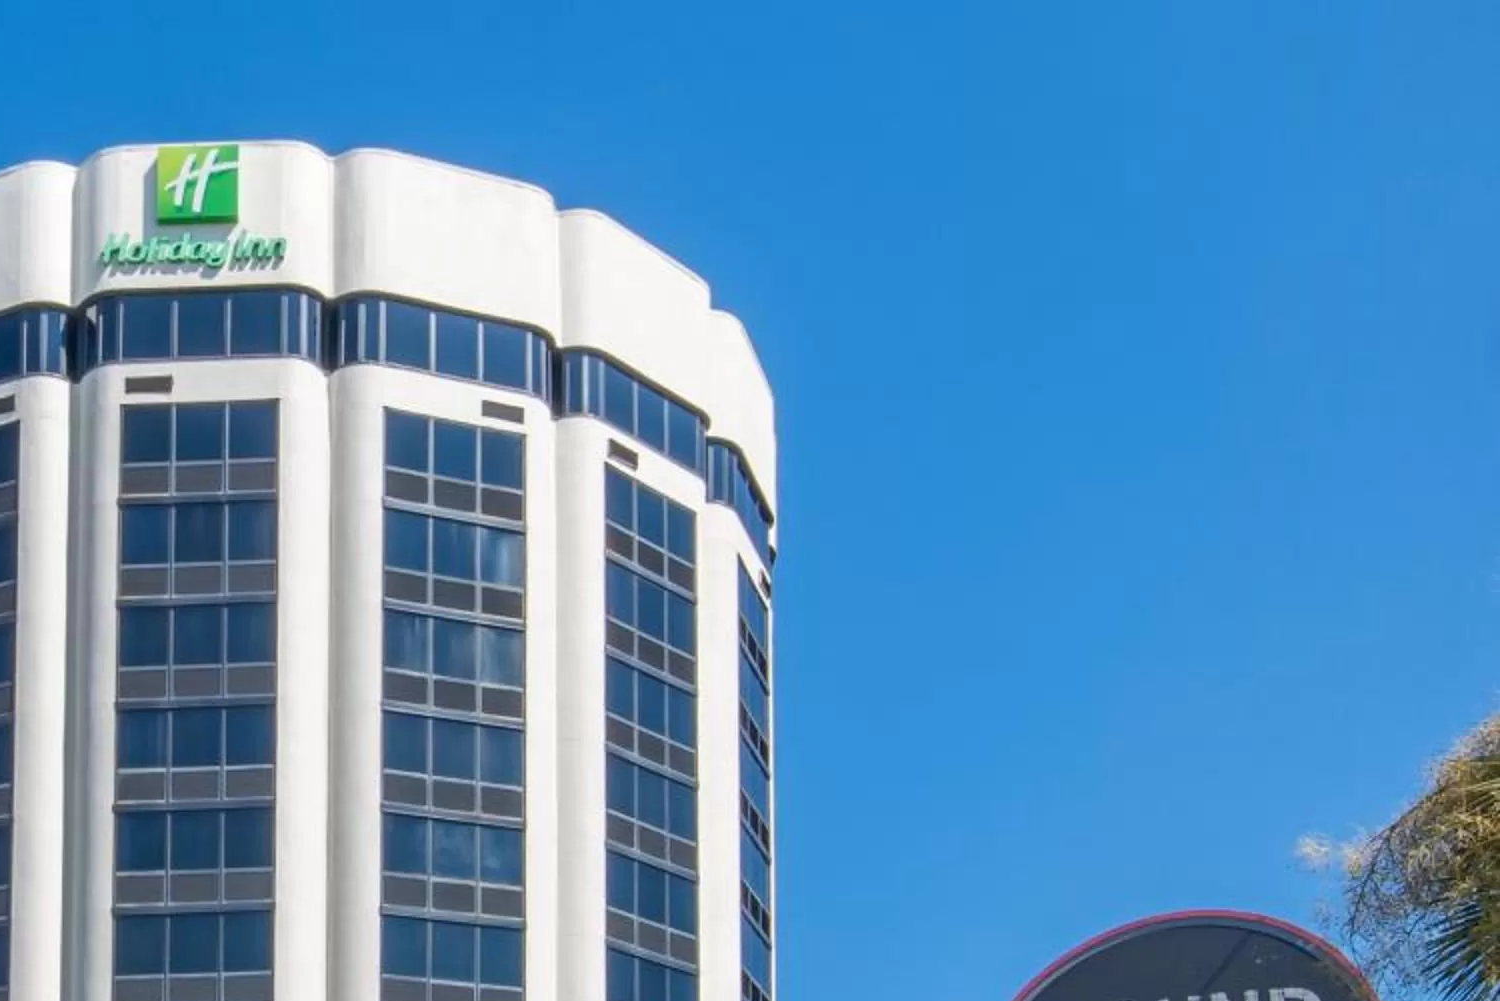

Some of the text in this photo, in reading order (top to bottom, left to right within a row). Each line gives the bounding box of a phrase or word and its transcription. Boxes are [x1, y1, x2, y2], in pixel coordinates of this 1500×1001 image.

[164, 148, 238, 213] H
[100, 229, 286, 268] Holiday Inn
